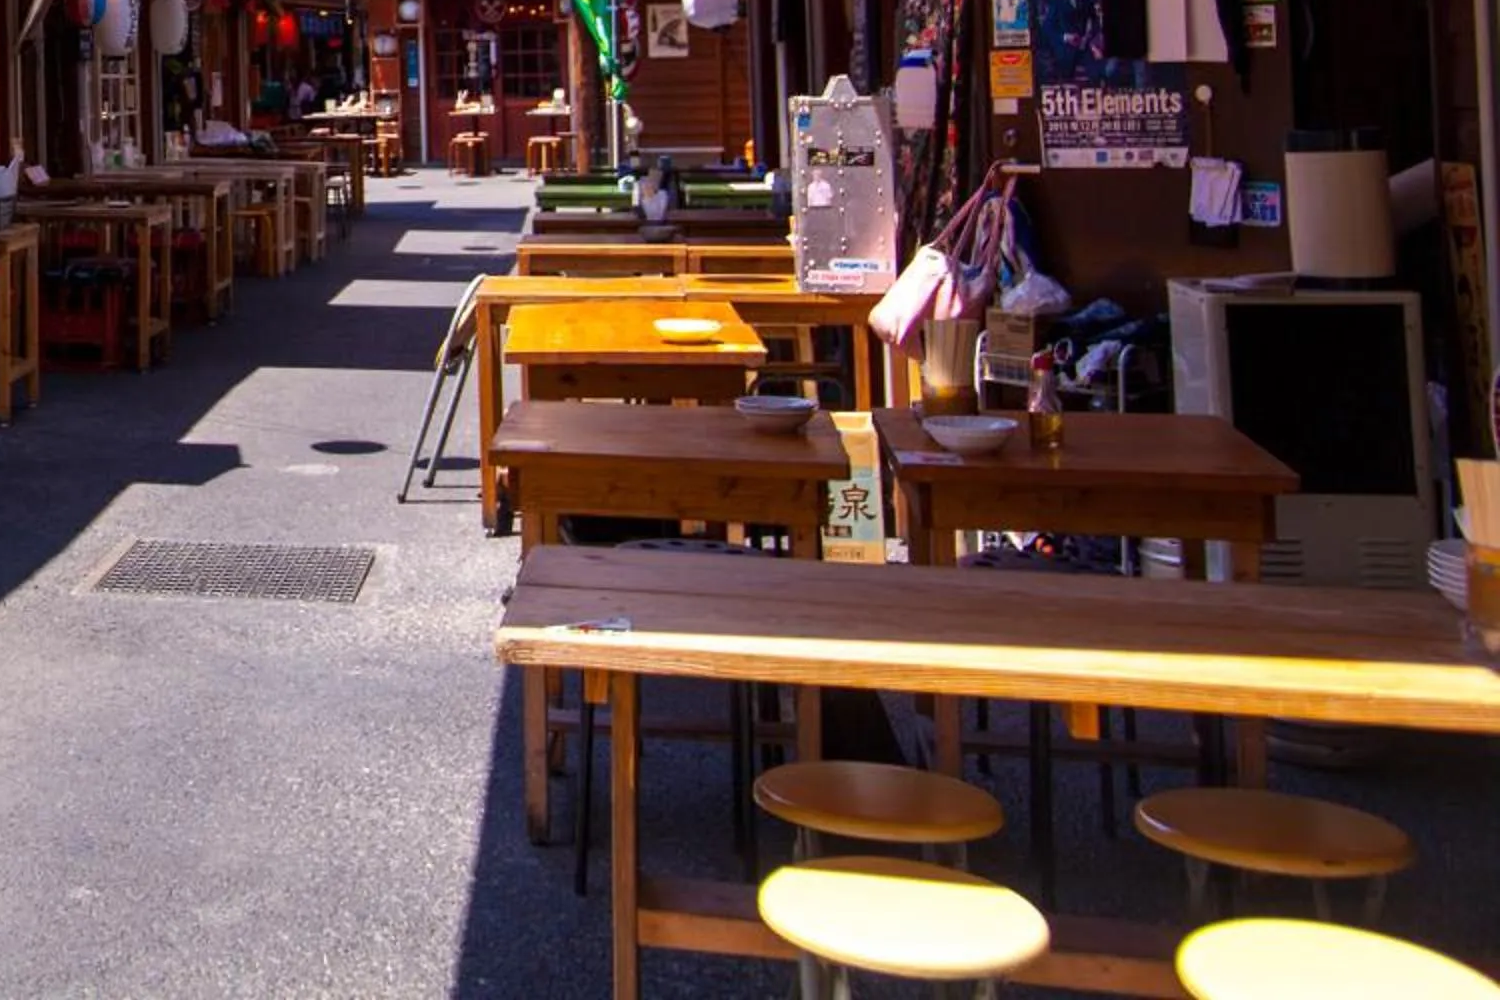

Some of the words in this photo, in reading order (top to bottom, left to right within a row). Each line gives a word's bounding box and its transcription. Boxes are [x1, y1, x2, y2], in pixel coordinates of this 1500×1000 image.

[1041, 88, 1079, 117] 5th
[1081, 86, 1184, 115] Elements
[828, 482, 877, 522] 泉
